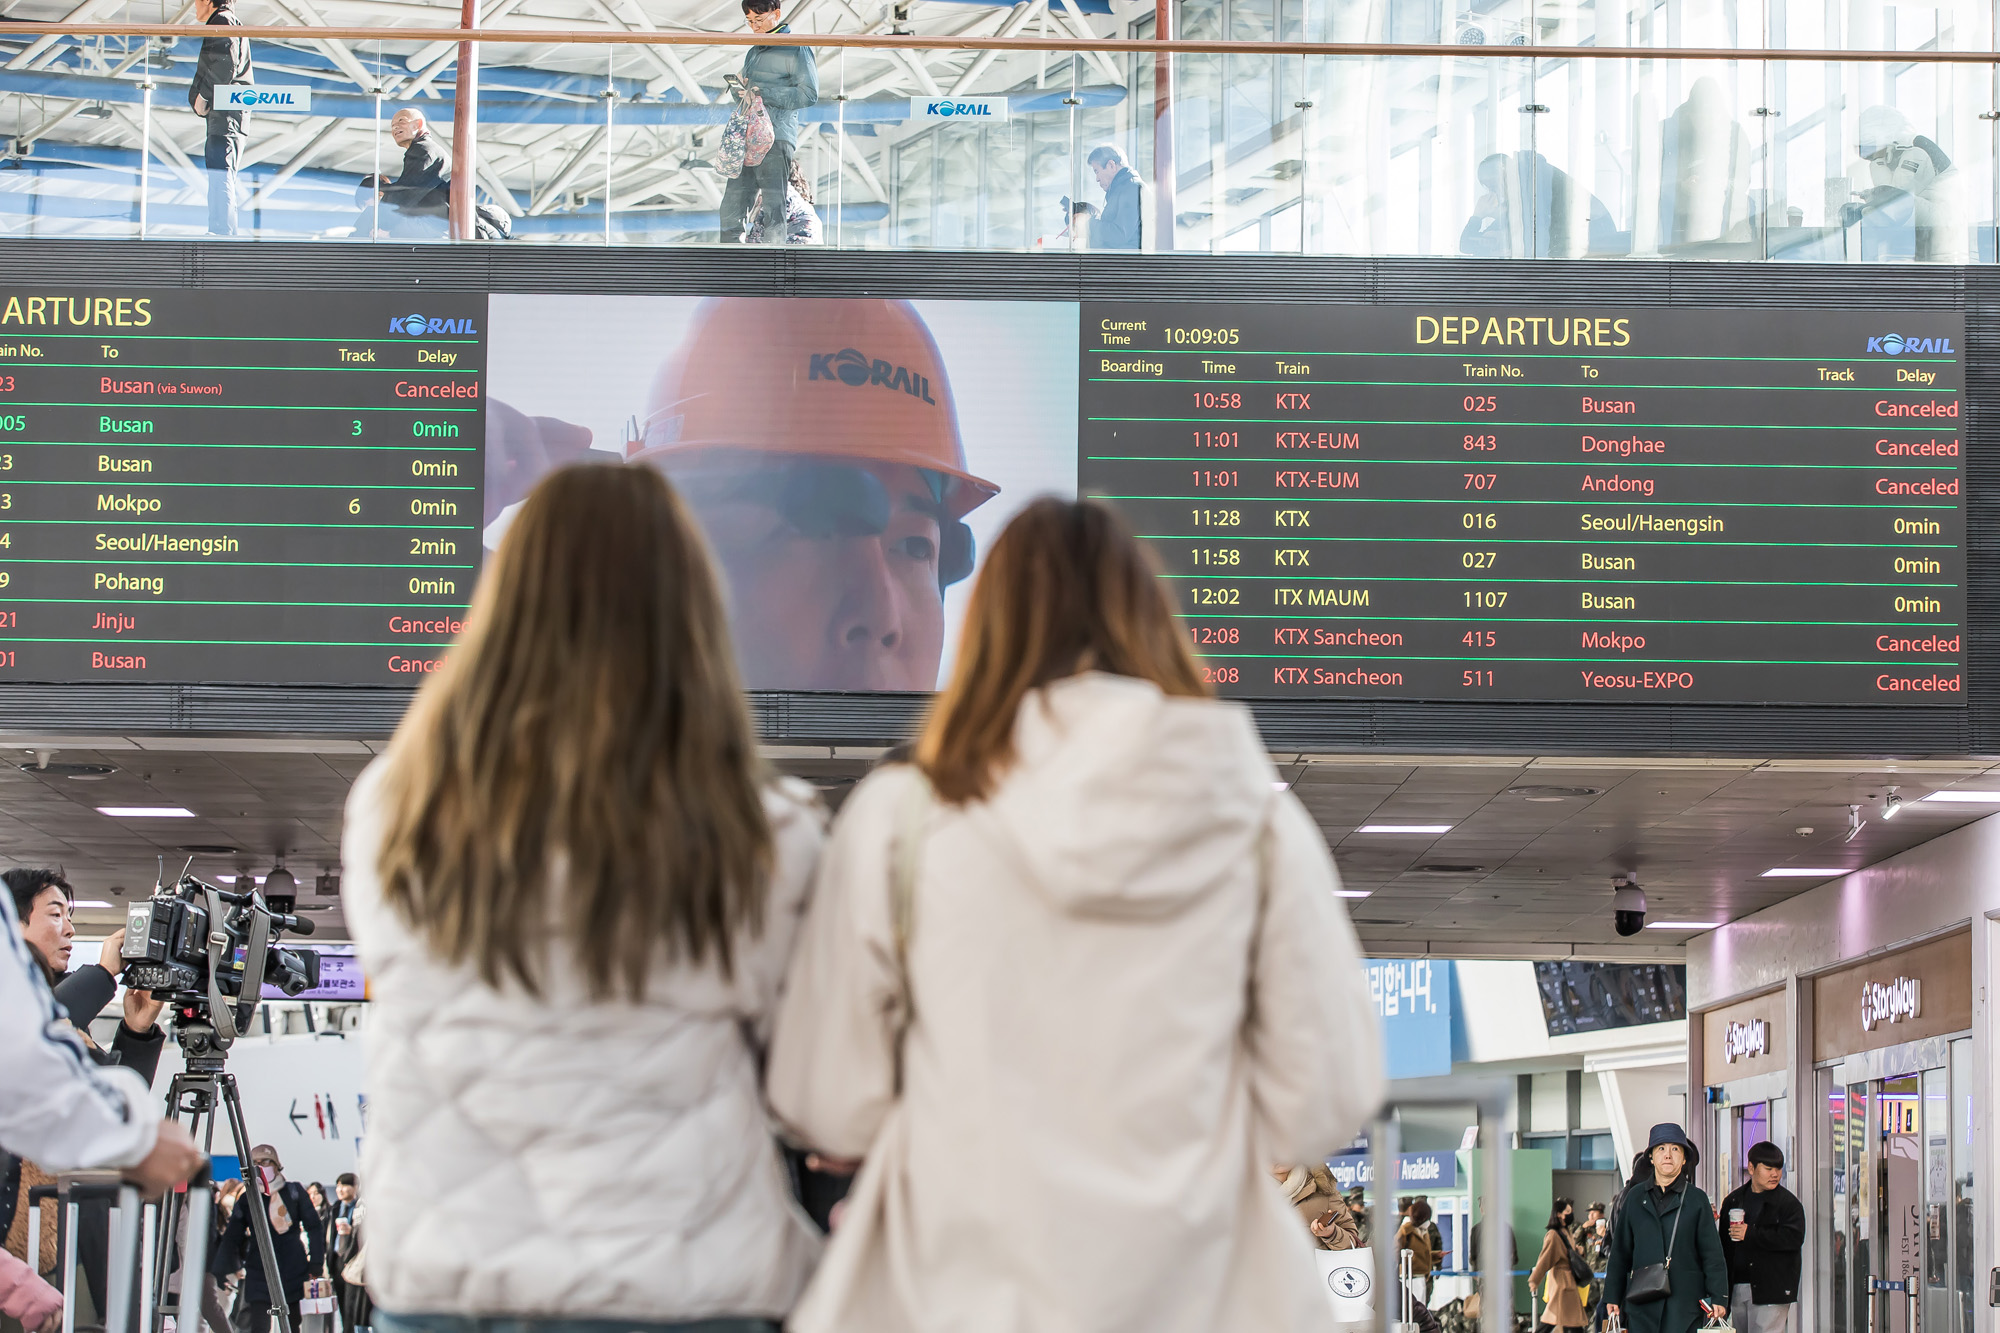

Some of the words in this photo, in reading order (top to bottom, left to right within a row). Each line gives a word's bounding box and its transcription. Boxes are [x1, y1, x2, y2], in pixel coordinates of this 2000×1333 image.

[229, 89, 295, 106] KORAIL
[926, 100, 992, 117] KORAIL
[388, 313, 478, 337] KORAIL
[1101, 318, 1147, 331] Current
[1416, 315, 1631, 347] DEPARTURES
[1100, 332, 1131, 345] Time
[1164, 327, 1240, 345] 10:09:05
[1866, 332, 1955, 356] KORAIL
[19, 343, 44, 358] No.
[100, 344, 119, 359] To
[338, 348, 376, 362] Track
[417, 349, 458, 367] Delay
[1101, 359, 1164, 376] Boarding
[1201, 360, 1236, 374] Time
[1275, 361, 1310, 375] Train
[1462, 363, 1498, 377] Train
[1500, 364, 1525, 378] No.
[1580, 364, 1599, 379] To
[1816, 367, 1856, 382] Track
[100, 376, 155, 394] Busan
[157, 382, 177, 395] (via
[179, 382, 223, 396] Suwon)
[809, 348, 936, 406] KORAIL
[1896, 368, 1937, 386] Delay
[394, 380, 479, 399] Canceled
[1193, 392, 1242, 409] 10:58
[1276, 392, 1311, 410] KTX
[1463, 395, 1497, 412] 025
[1582, 396, 1636, 414] Busan
[1874, 399, 1959, 418] Canceled
[99, 415, 154, 434] Busan
[351, 419, 363, 436] 3
[412, 420, 459, 438] 0min
[1193, 431, 1238, 448] 11:01
[1276, 431, 1360, 450] KTX-EUM
[1463, 434, 1497, 451] 843
[1581, 435, 1666, 458] Donghae
[1875, 438, 1959, 457] Canceled
[98, 454, 153, 473] Busan
[411, 459, 458, 477] 0min
[1192, 470, 1238, 487] 11:01
[1275, 470, 1360, 489] KTX-EUM
[1463, 473, 1497, 490] 707
[1581, 474, 1655, 497] Andong
[1875, 477, 1960, 496] Canceled
[96, 493, 162, 515] Mokpo
[348, 497, 361, 515] 6
[410, 498, 457, 516] 0min
[1192, 509, 1241, 526] 11:28
[1275, 510, 1311, 527] KTX
[1462, 512, 1497, 529] 016
[1581, 513, 1724, 536] Seoul/Haengsin
[1893, 517, 1941, 535] 0min
[95, 532, 239, 556] Seoul/Haengsin
[409, 537, 456, 555] 2min
[1191, 548, 1241, 566] 11:58
[1274, 549, 1310, 567] KTX
[1462, 552, 1497, 569] 027
[1581, 552, 1636, 571] Busan
[1894, 556, 1941, 574] 0min
[94, 572, 164, 595] Pohang
[408, 577, 455, 595] 0min
[1191, 588, 1240, 605] 12:02
[1274, 588, 1303, 606] ITX
[1307, 588, 1370, 607] MAUM
[1463, 591, 1508, 608] 1107
[1581, 592, 1636, 610] Busan
[1894, 596, 1941, 613] 0min
[91, 612, 135, 634] Jinju
[1190, 626, 1240, 645] 12:08
[1274, 628, 1310, 645] KTX
[1313, 628, 1403, 646] Sancheon
[1461, 630, 1496, 647] 415
[1581, 630, 1646, 653] Mokpo
[1875, 634, 1960, 653] Canceled
[91, 651, 147, 669] Busan
[1201, 666, 1240, 684] 2:08
[1274, 667, 1309, 685] KTX
[1313, 667, 1403, 686] Sancheon
[1462, 670, 1493, 687] 511
[1581, 670, 1694, 689] Yeosu-EXPO
[1876, 673, 1961, 692] Canceled
[1364, 959, 1437, 1017] 리합니다.
[1401, 1156, 1440, 1181] Available
